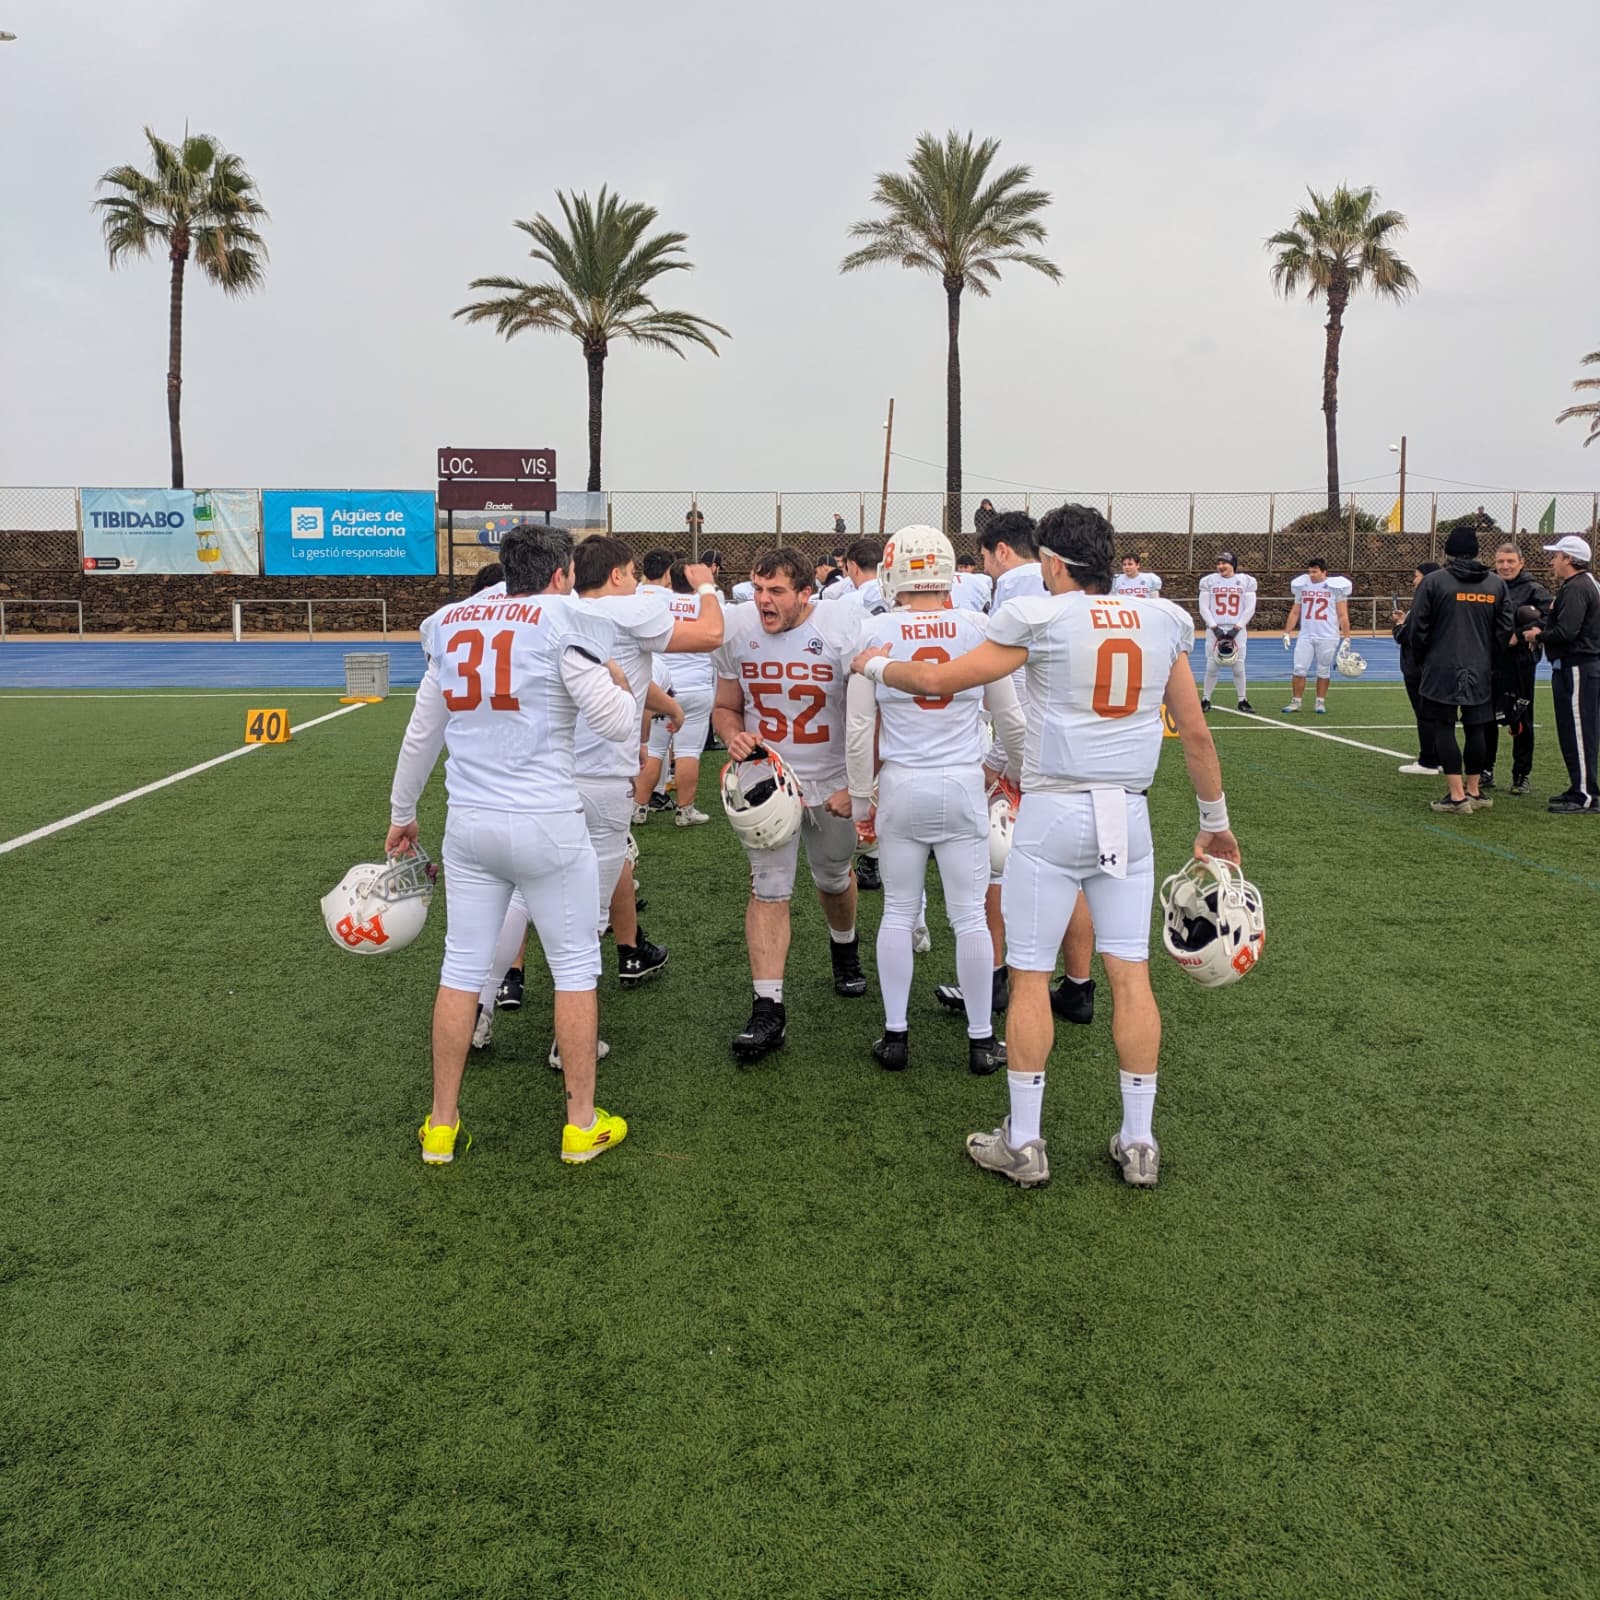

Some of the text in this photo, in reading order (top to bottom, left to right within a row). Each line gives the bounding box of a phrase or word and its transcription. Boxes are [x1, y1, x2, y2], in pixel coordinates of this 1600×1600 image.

[440, 457, 551, 475] LOC. VIS.
[90, 511, 184, 528] TIBIDABO
[330, 508, 404, 525] Aigües de
[332, 525, 406, 537] Barcelona
[291, 547, 407, 560] La gestió responsable
[1215, 593, 1240, 617] 59
[1456, 592, 1496, 603] BOCS
[441, 603, 542, 626] ARGENTONA
[669, 602, 696, 614] LEON
[1302, 597, 1328, 620] 72
[1090, 609, 1140, 629] ELOI
[901, 622, 957, 640] RENIU
[442, 629, 520, 711] 31
[741, 661, 834, 682] BOCS
[1092, 638, 1143, 719] 0
[749, 683, 830, 744] 52
[250, 712, 281, 741] 40
